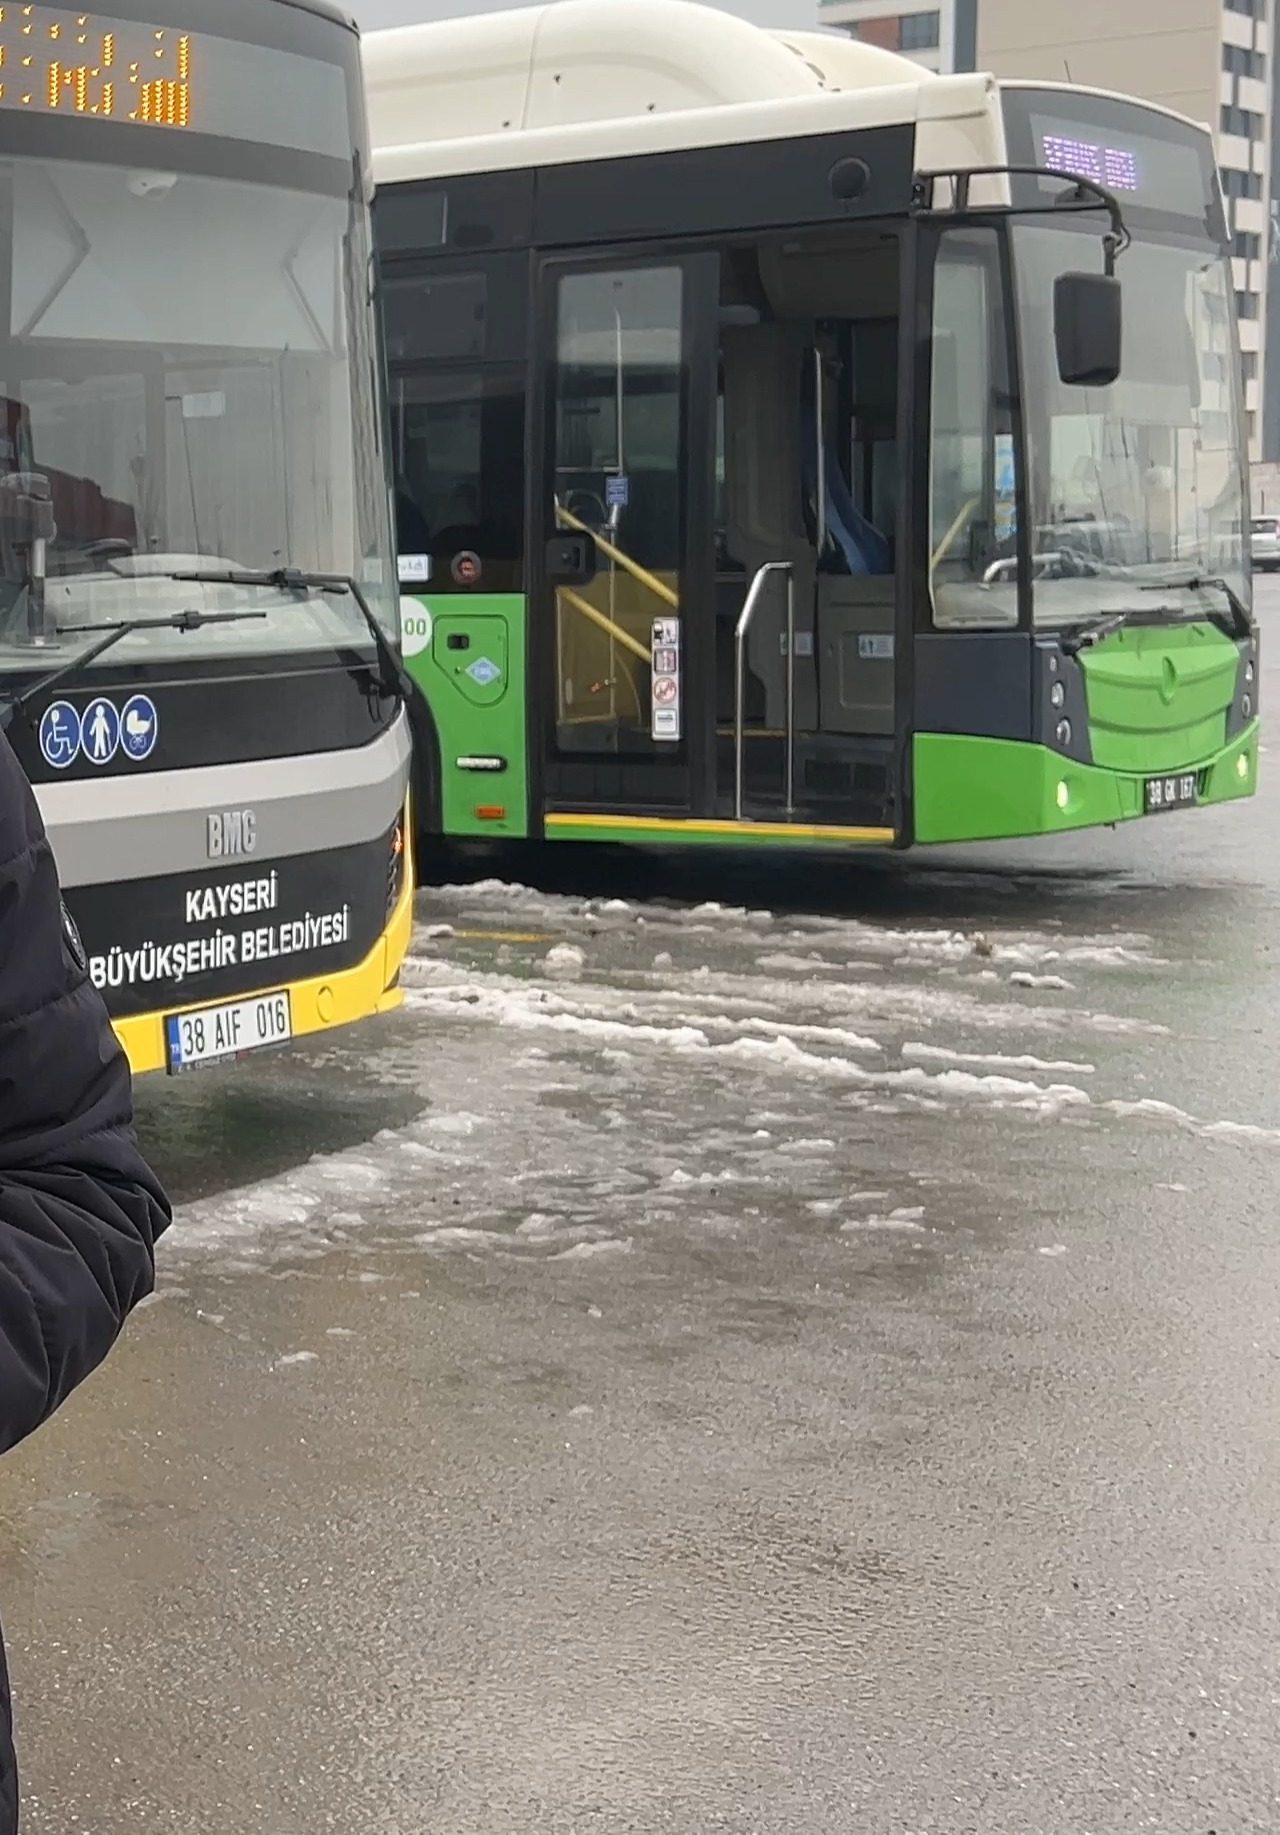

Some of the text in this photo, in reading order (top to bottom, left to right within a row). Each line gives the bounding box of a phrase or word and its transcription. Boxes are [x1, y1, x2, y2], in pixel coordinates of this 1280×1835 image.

[404, 617, 427, 636] 00
[206, 809, 258, 860] BMC
[185, 869, 278, 923] KAYSERİ
[88, 903, 351, 990] BÜYÜKŞEHİR BELEDİYESİ
[182, 998, 286, 1056] 38 AIF 016
